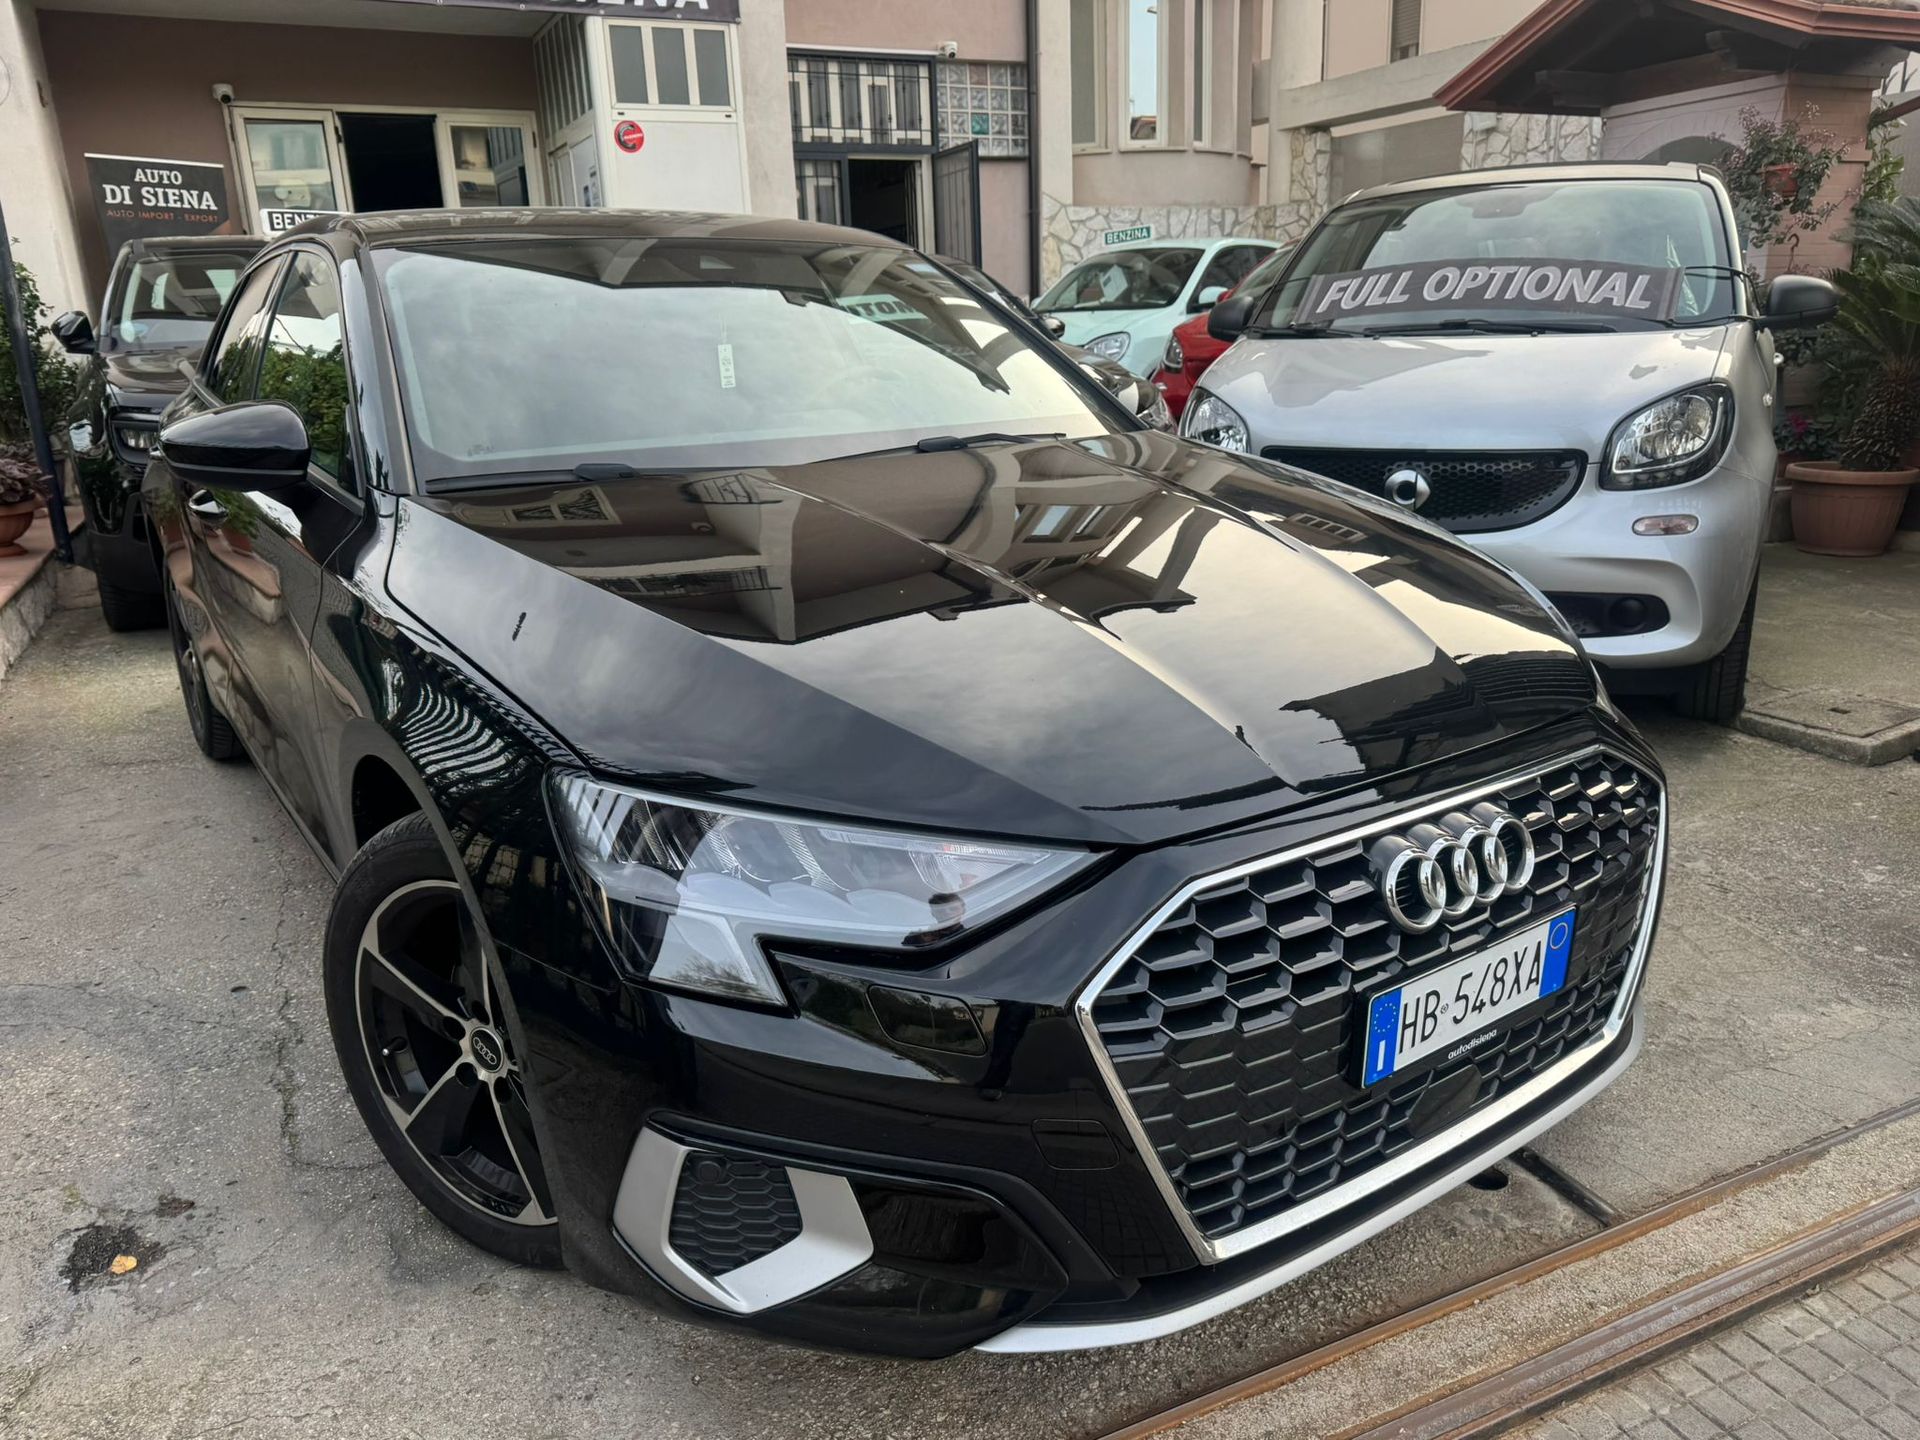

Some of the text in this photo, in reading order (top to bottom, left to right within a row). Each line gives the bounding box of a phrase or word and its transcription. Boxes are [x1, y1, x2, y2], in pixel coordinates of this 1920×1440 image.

[134, 168, 183, 185] AUTO
[102, 184, 218, 210] DI SIENA
[106, 209, 135, 218] AUTO
[138, 211, 174, 220] IMPORT
[184, 213, 218, 223] EXPORT
[1107, 228, 1148, 244] BENZINA
[1315, 266, 1651, 313] FULL OPTIONAL
[1399, 940, 1542, 1055] HB 548XA
[1447, 1029, 1497, 1060] autodisiena
